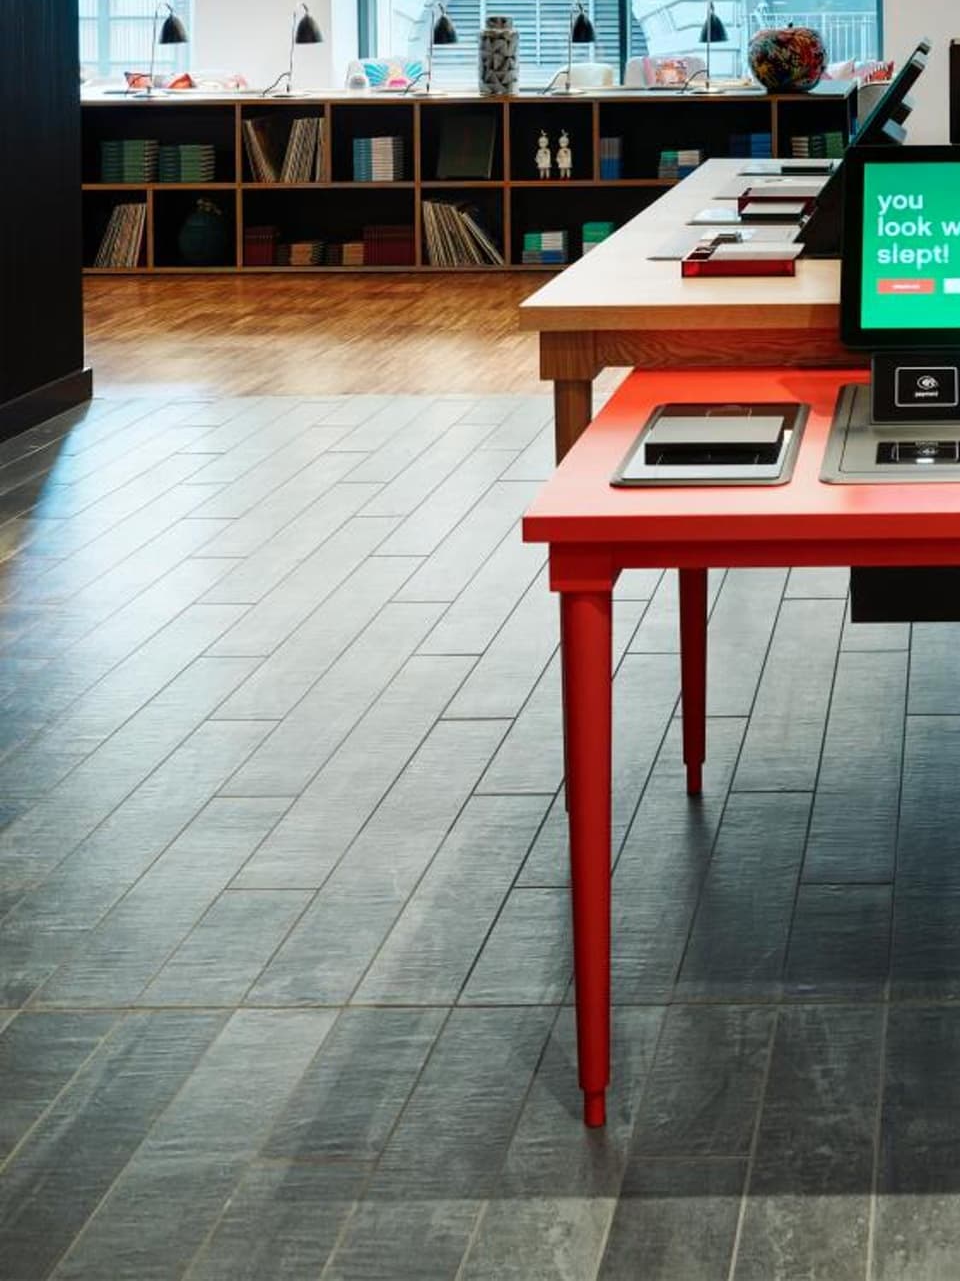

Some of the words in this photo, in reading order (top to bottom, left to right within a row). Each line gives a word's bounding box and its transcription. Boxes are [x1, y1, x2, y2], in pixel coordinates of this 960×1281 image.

[877, 194, 924, 216] you
[877, 216, 932, 237] look
[877, 242, 949, 270] slept!
